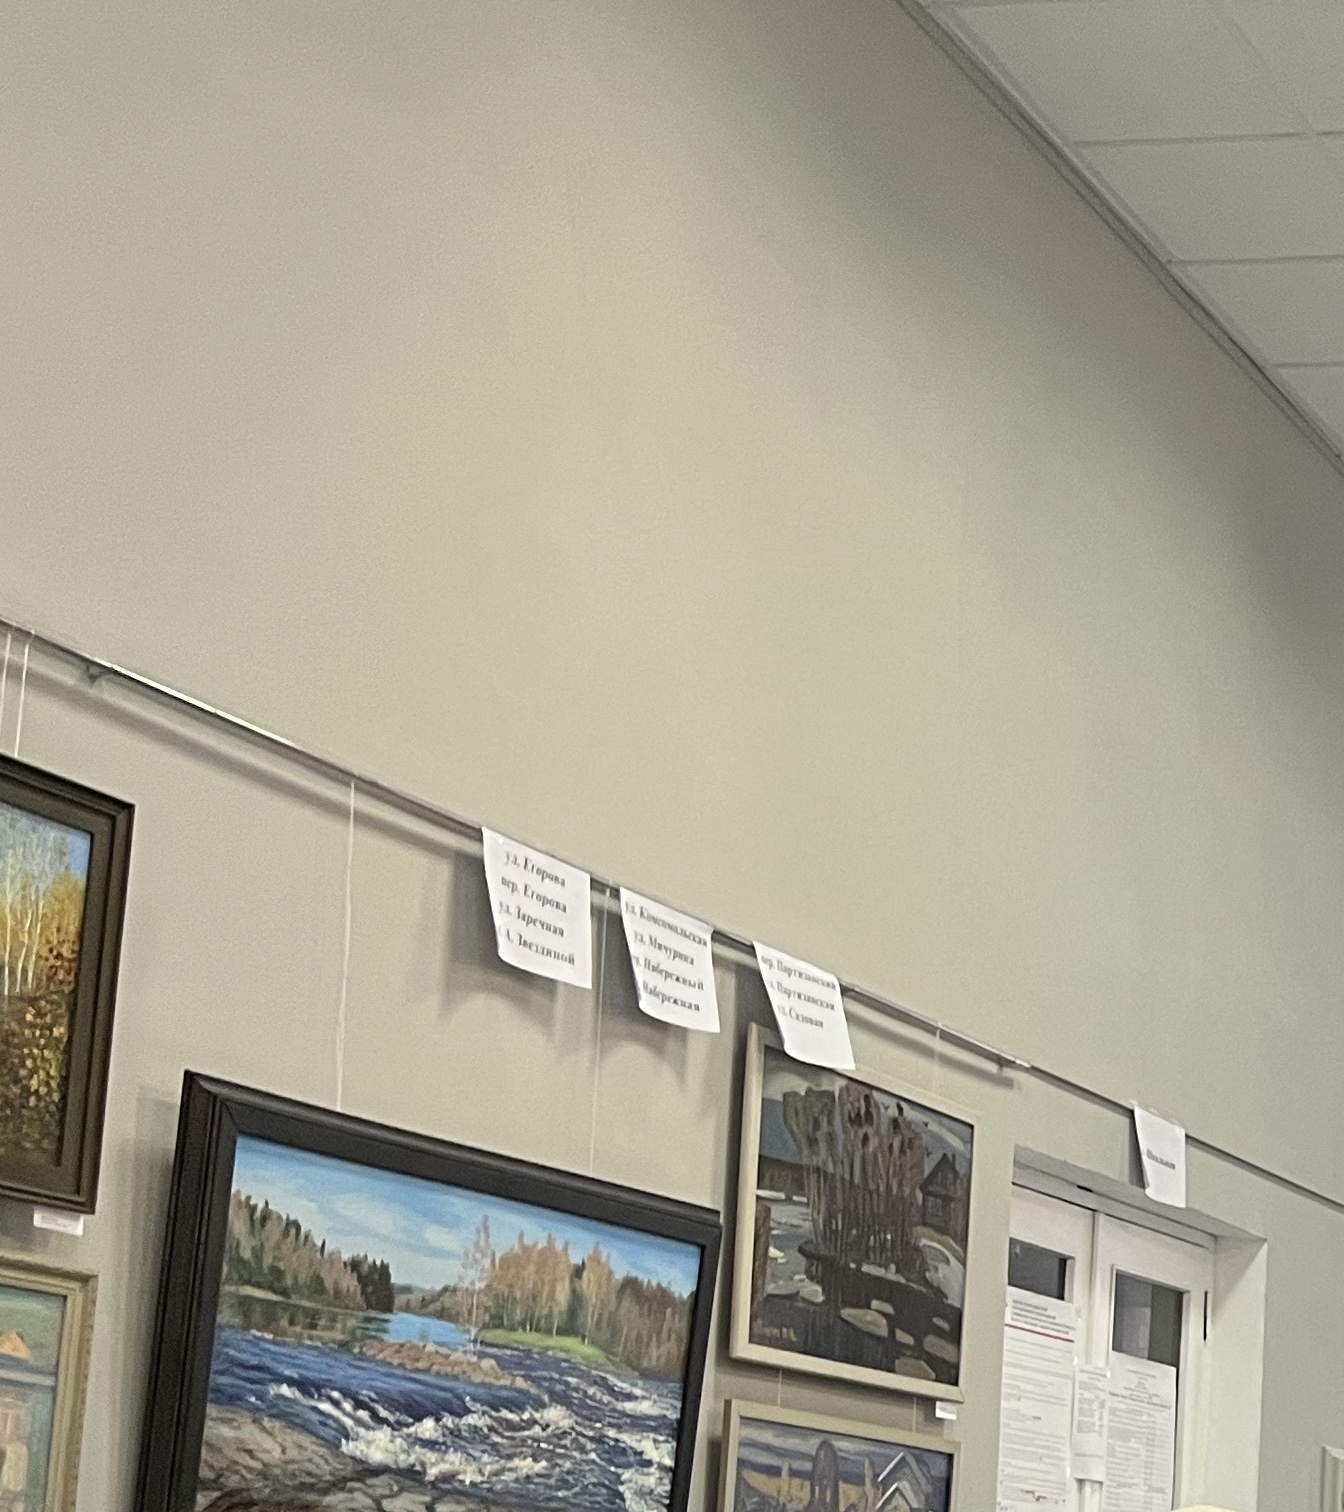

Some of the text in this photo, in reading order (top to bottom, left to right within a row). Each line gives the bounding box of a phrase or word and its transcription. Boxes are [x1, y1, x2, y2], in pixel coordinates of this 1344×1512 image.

[523, 856, 566, 887] Егорова
[523, 883, 567, 913] Егорова
[515, 905, 565, 938] Заречная
[649, 935, 694, 966] Мичурина
